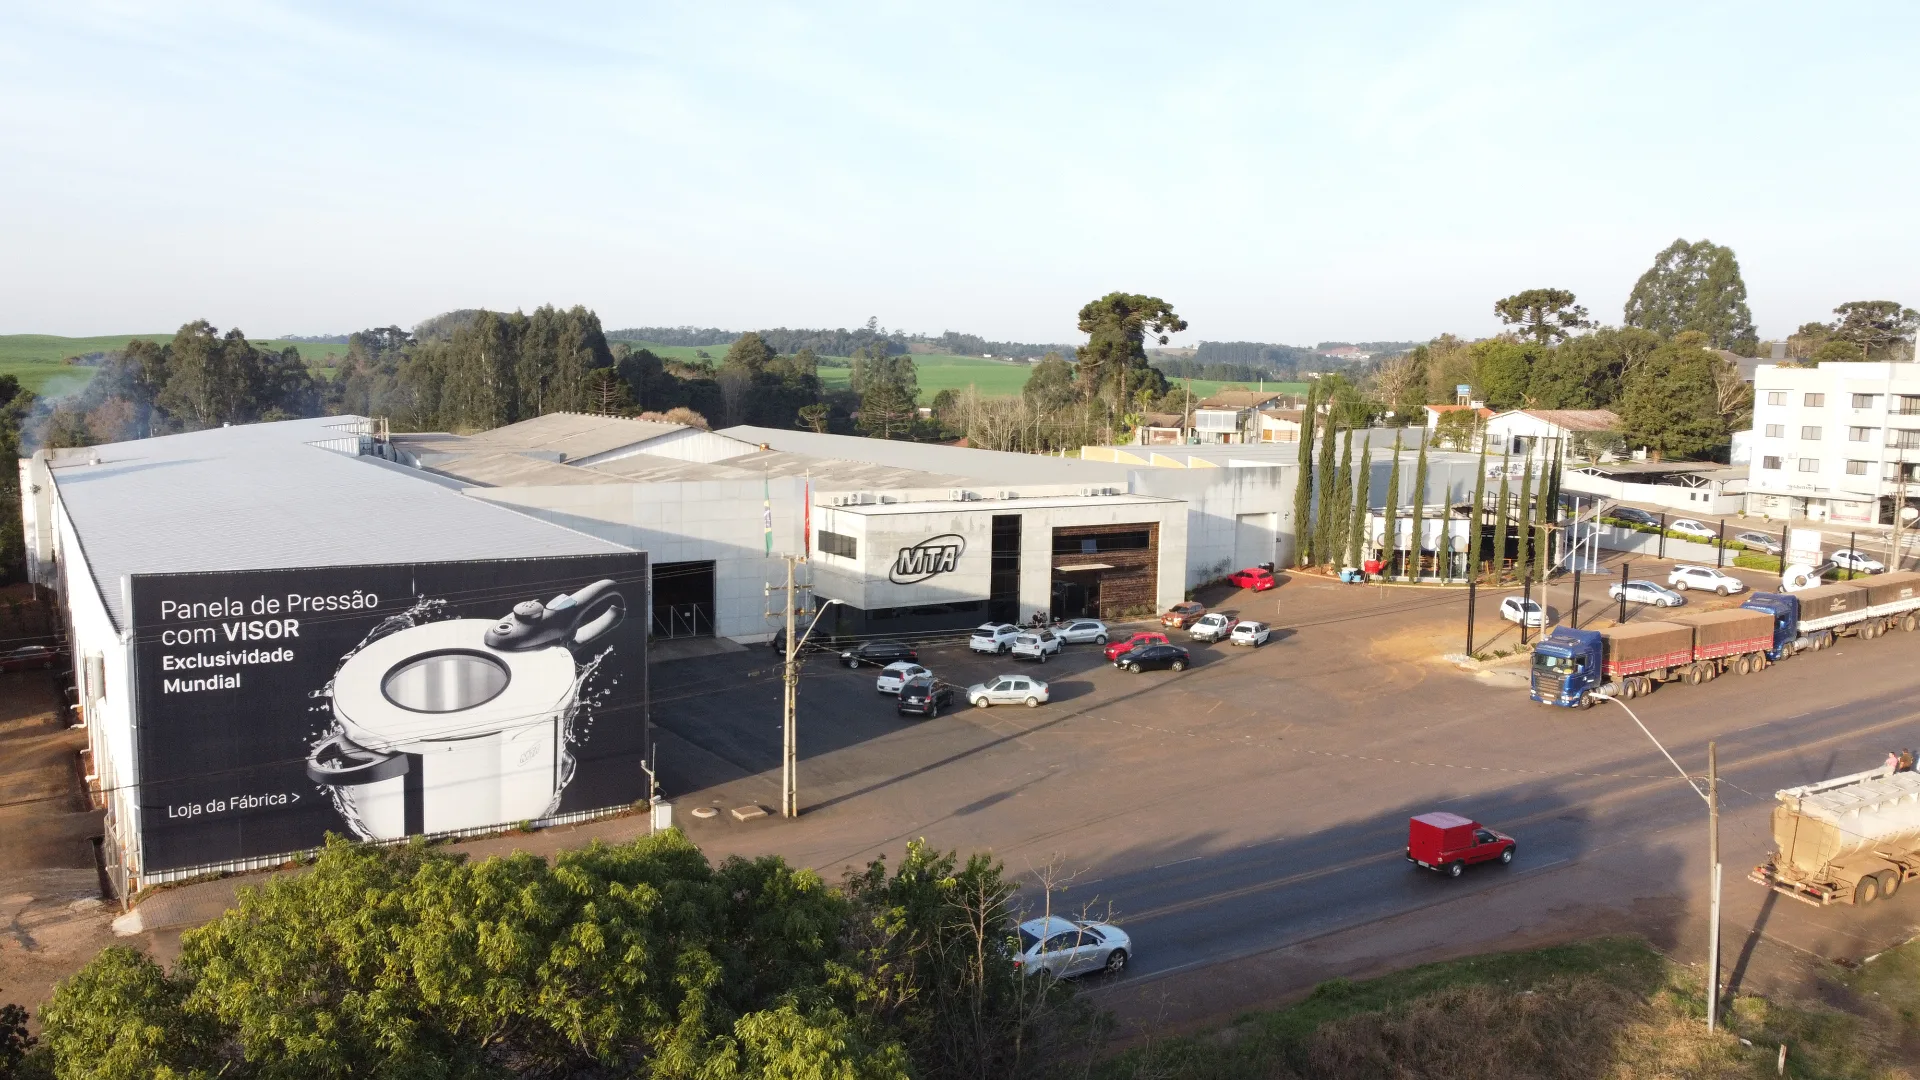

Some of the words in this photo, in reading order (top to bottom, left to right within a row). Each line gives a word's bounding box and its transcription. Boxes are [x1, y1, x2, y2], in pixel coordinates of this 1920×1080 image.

[896, 545, 959, 575] MTA
[161, 596, 244, 620] Panela
[251, 594, 280, 615] de
[287, 589, 379, 613] Pressão
[161, 627, 217, 646] com
[222, 618, 300, 642] VISOR
[162, 647, 294, 671] Exclusividade
[163, 673, 241, 694] Mundial
[168, 802, 202, 819] Loja
[205, 798, 226, 813] da
[230, 792, 287, 810] Fábrica
